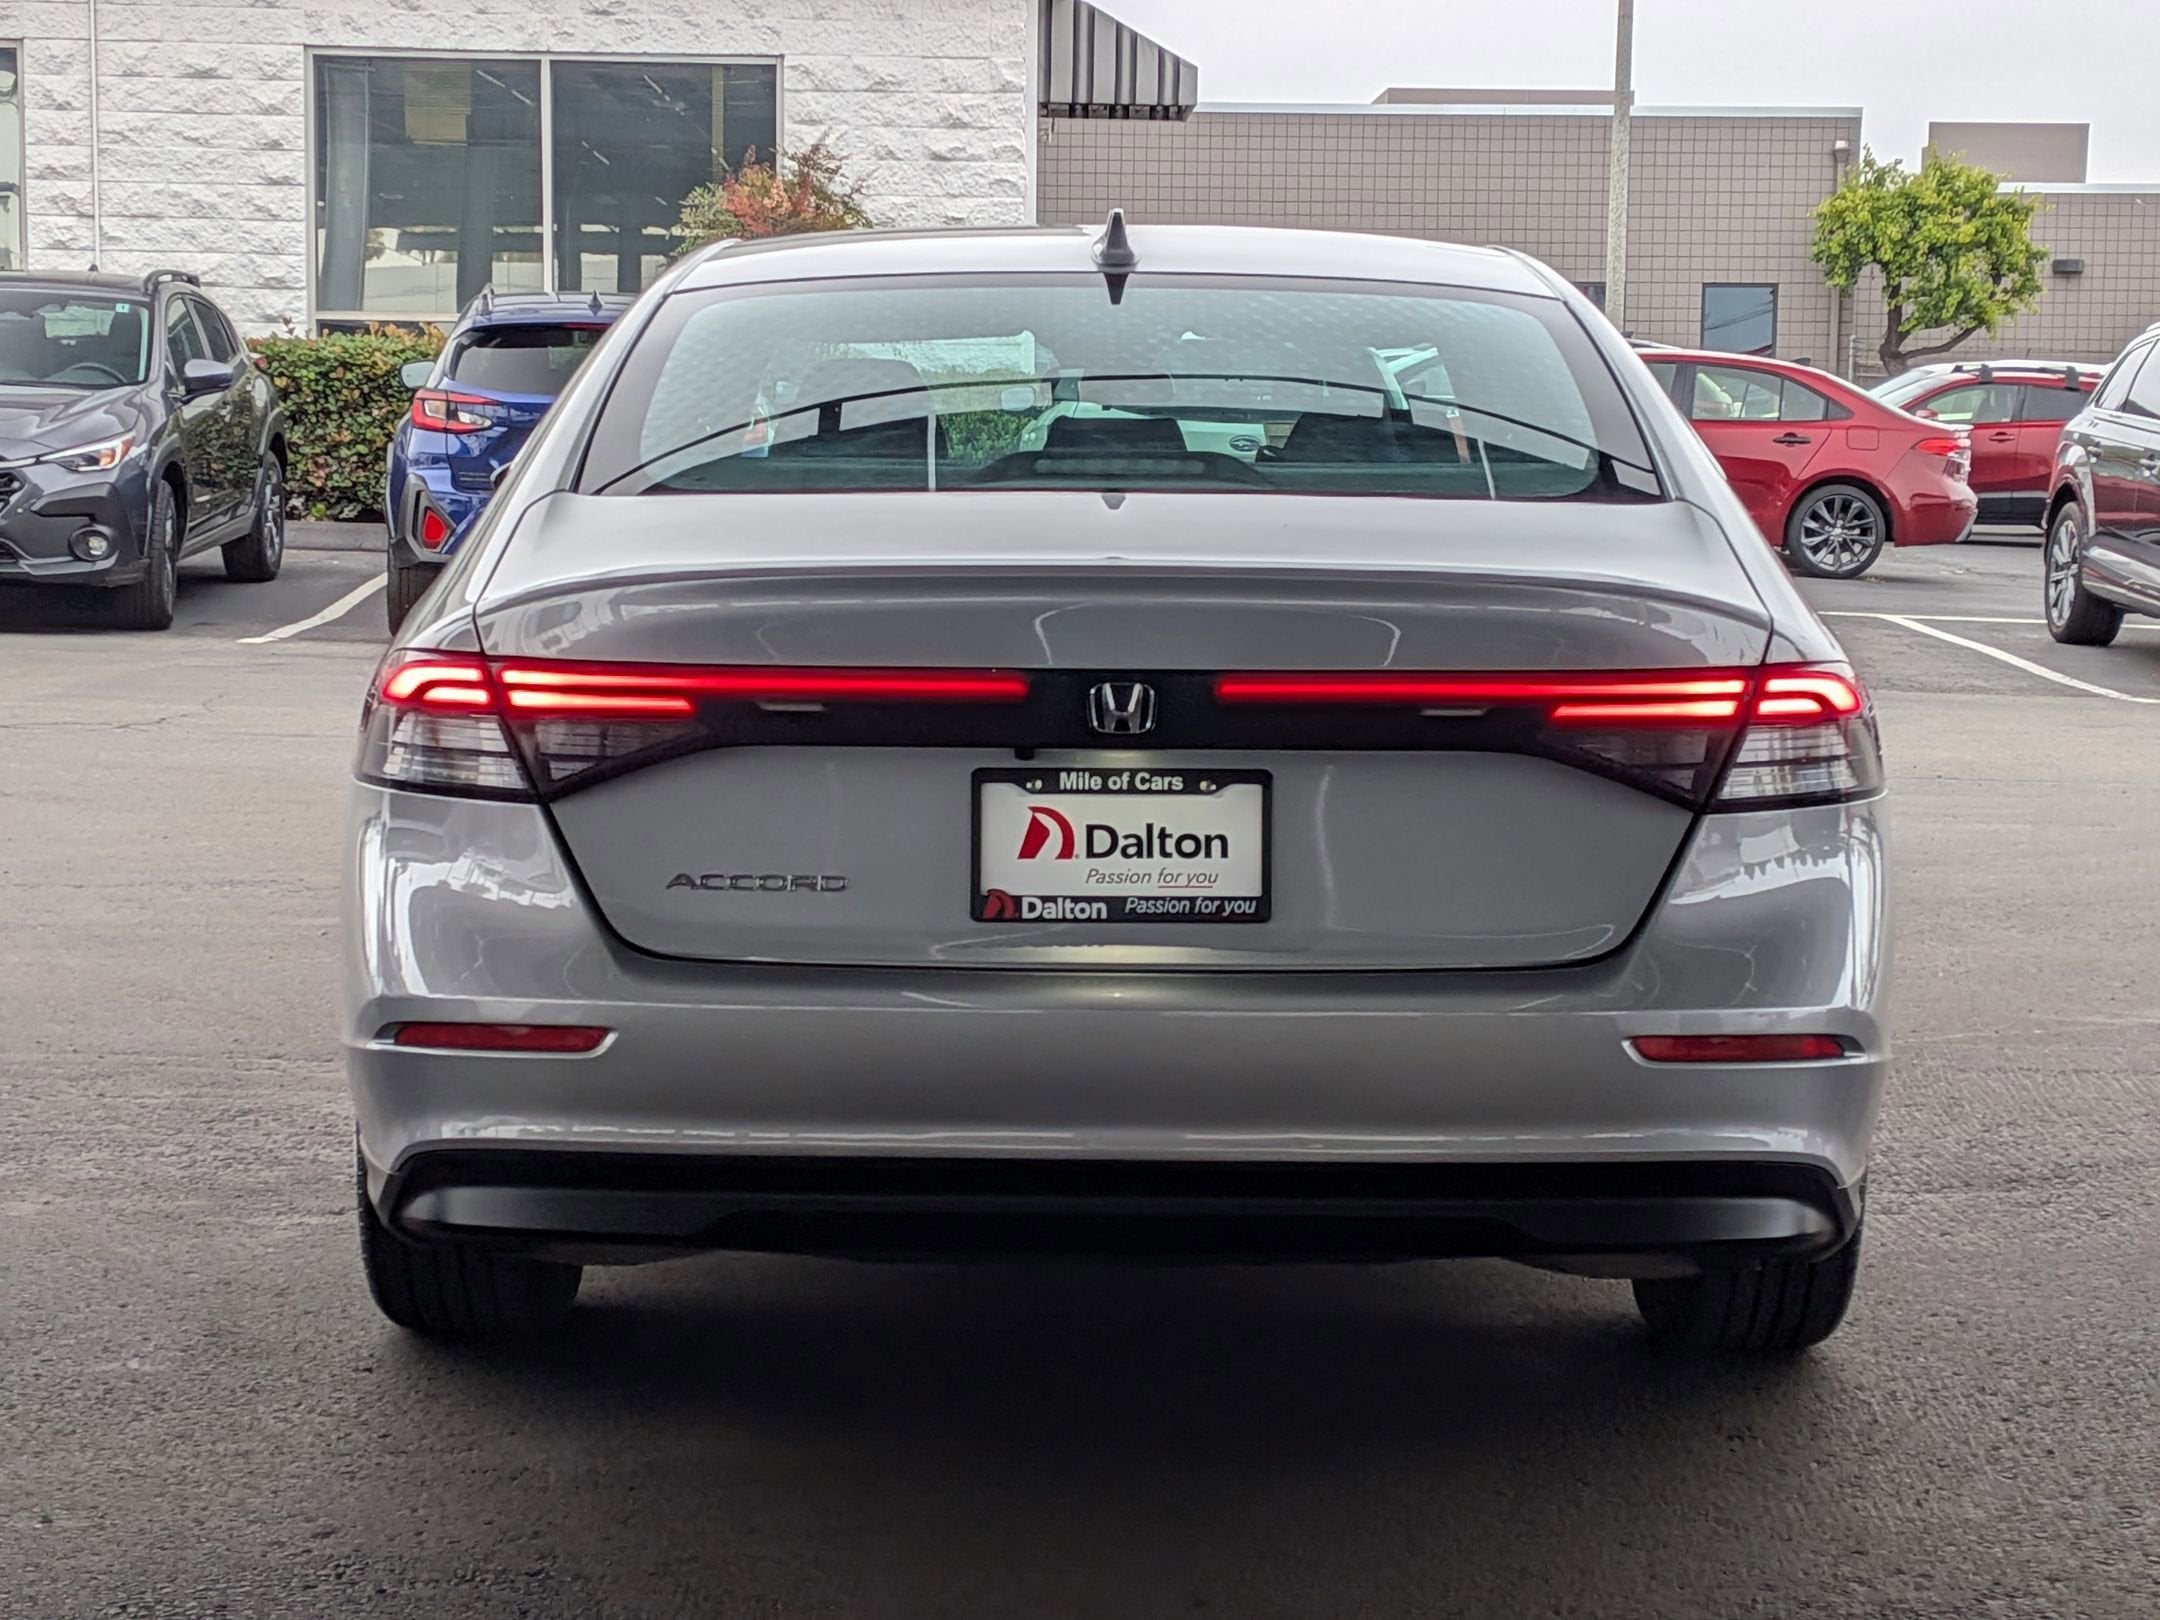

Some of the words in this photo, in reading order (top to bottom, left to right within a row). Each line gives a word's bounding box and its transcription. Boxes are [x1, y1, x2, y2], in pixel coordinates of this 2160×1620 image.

[1059, 771, 1102, 791] Mile
[1108, 771, 1131, 791] of
[1134, 772, 1184, 791] Cars
[1085, 823, 1229, 859] Dalton
[665, 873, 848, 892] ACCORD
[1085, 868, 1152, 884] Passion
[1156, 868, 1182, 886] for
[1184, 872, 1219, 887] you
[1021, 897, 1108, 920] Dalton
[1124, 897, 1190, 914] Passion
[1193, 898, 1222, 915] for
[1223, 901, 1257, 915] you
